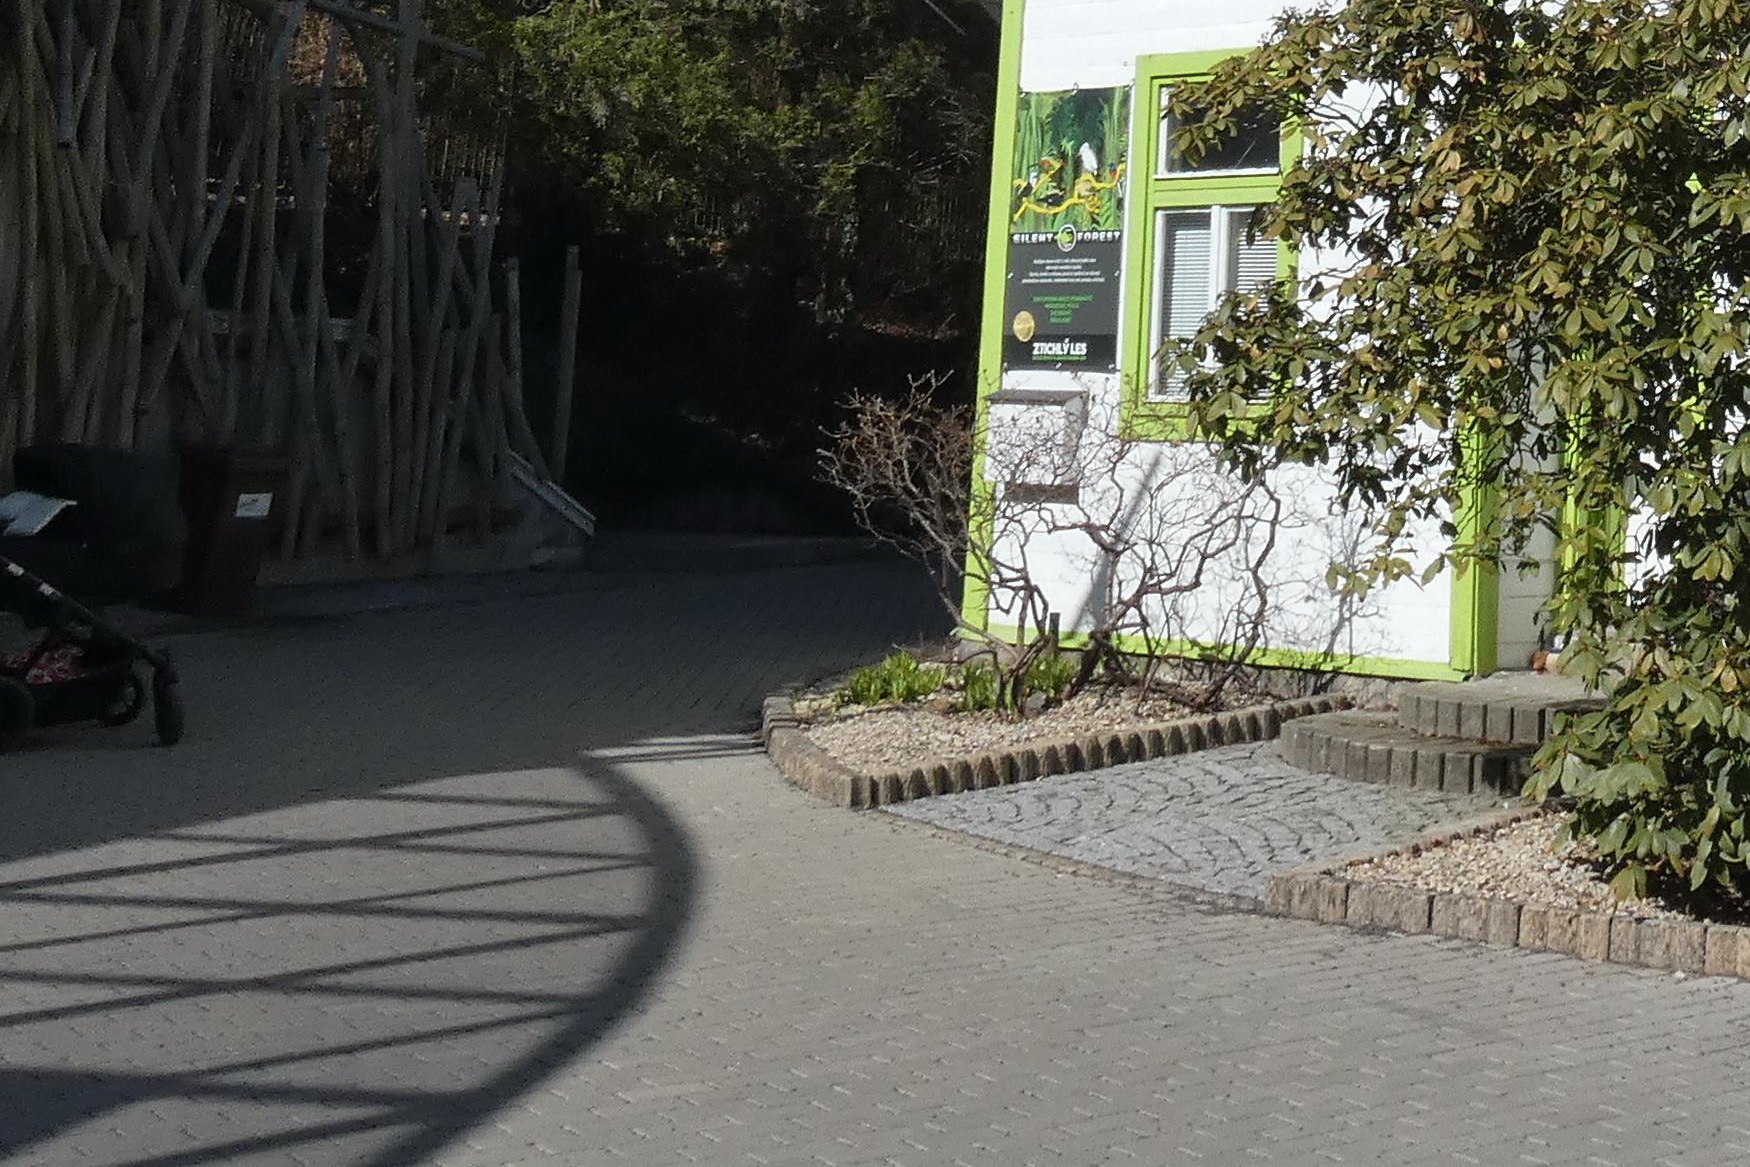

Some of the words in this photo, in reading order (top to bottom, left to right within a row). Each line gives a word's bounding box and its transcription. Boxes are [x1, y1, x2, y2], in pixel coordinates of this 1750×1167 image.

[1012, 233, 1054, 244] SILENT
[1077, 231, 1121, 243] FOREST
[1032, 337, 1070, 355] ZTICHLÝ
[1070, 342, 1087, 356] LES
